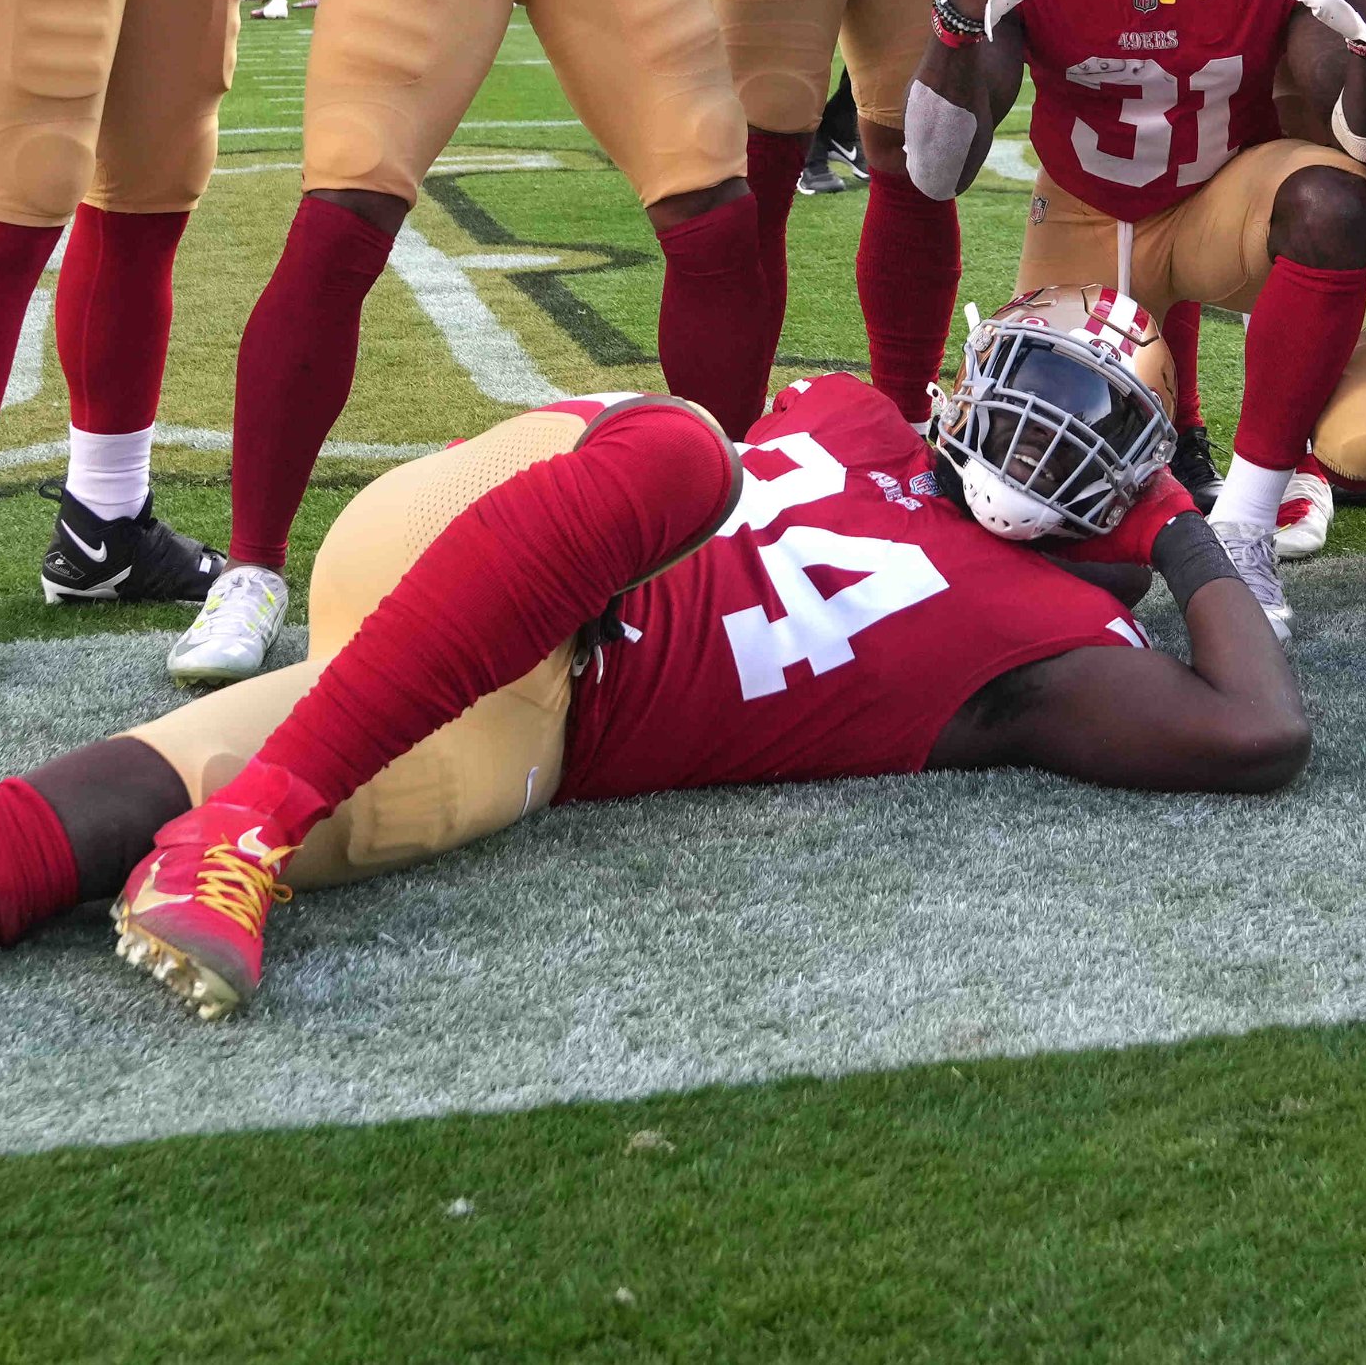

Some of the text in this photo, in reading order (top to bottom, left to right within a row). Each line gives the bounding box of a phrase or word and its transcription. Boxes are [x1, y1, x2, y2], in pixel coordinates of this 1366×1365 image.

[1117, 30, 1179, 51] 49ERS
[1066, 54, 1244, 188] 31
[866, 471, 924, 511] 49ERS
